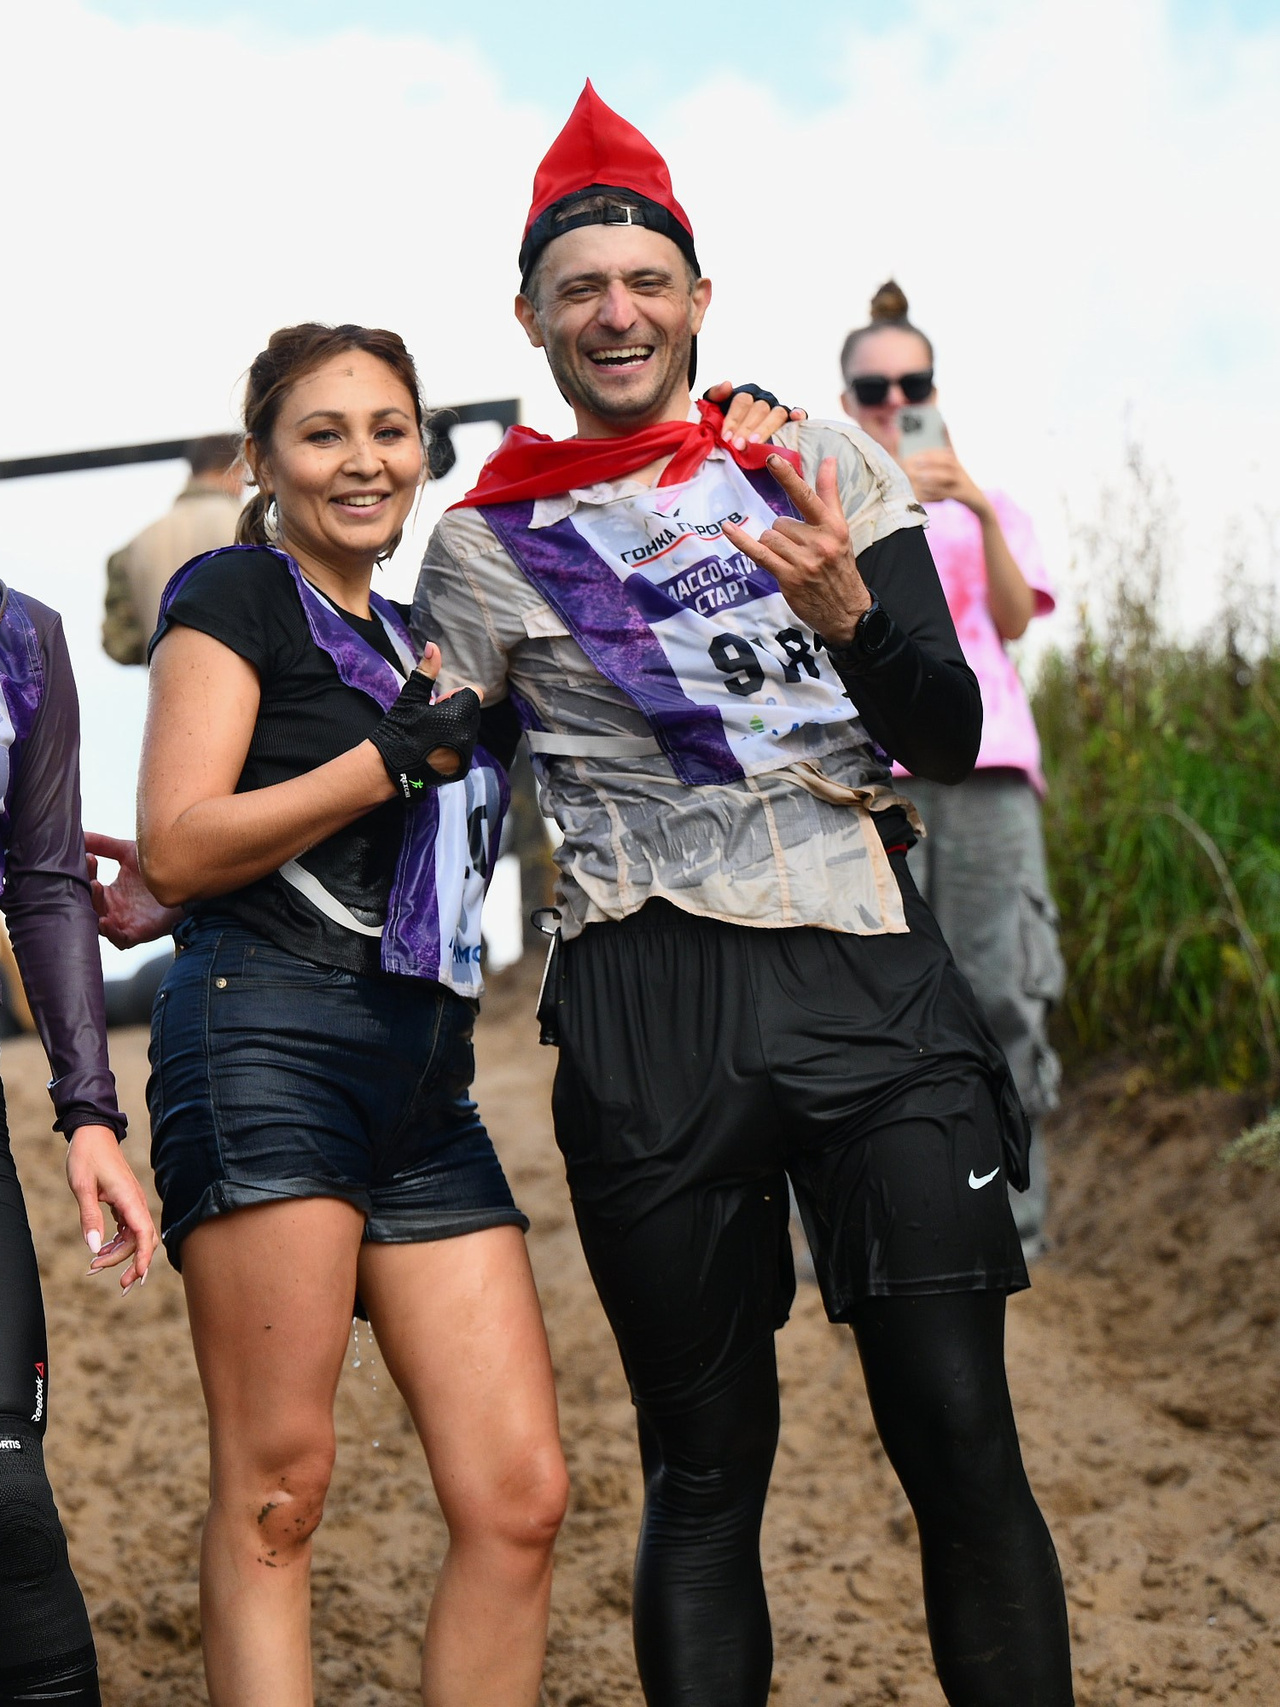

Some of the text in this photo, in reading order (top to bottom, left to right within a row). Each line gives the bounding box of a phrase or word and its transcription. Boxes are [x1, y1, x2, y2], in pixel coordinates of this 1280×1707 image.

[621, 528, 677, 563] ГОНКА
[693, 576, 750, 615] СТАРТ
[30, 1375, 44, 1422] Reebok
